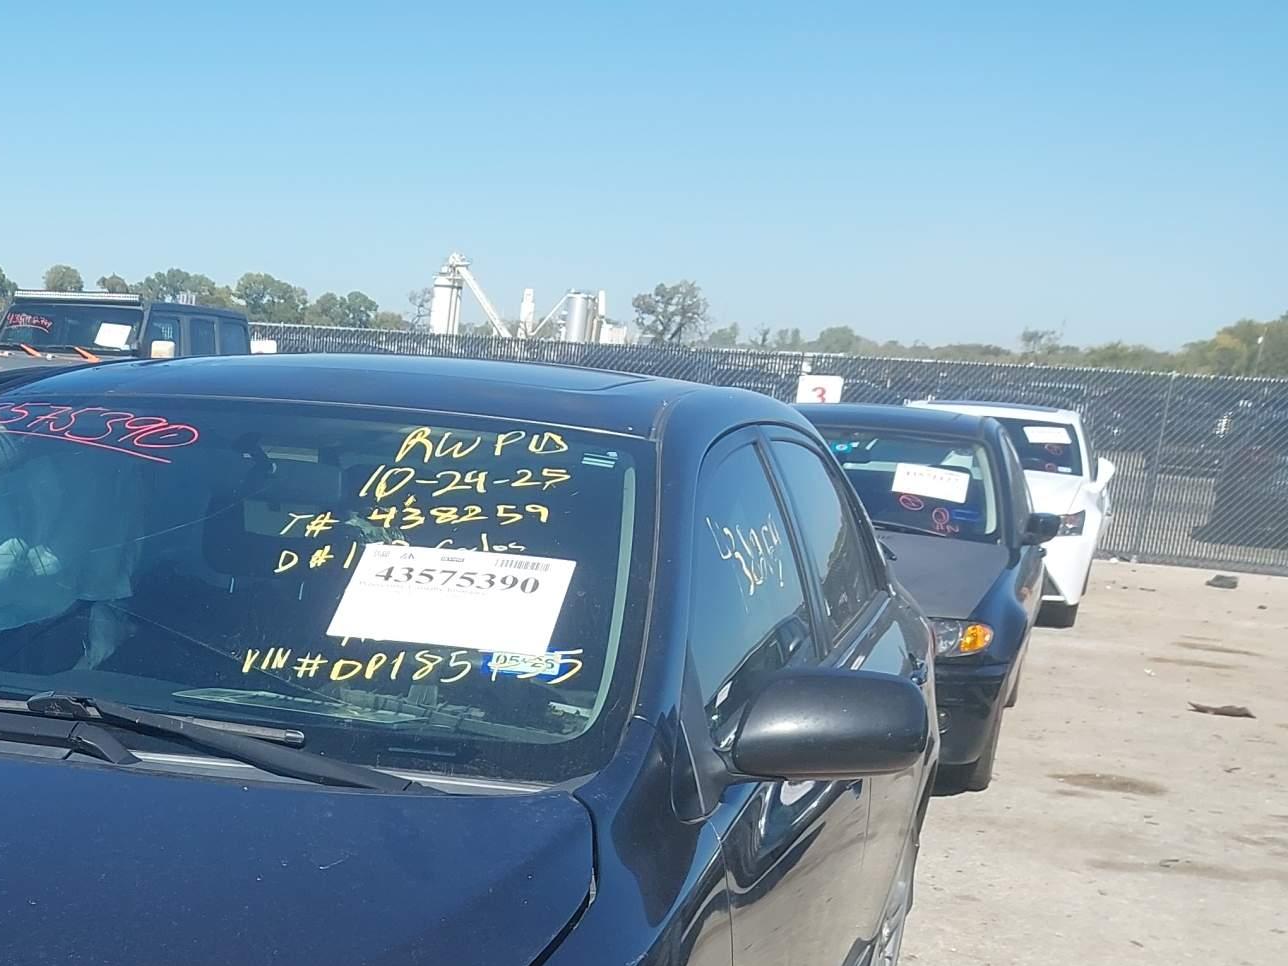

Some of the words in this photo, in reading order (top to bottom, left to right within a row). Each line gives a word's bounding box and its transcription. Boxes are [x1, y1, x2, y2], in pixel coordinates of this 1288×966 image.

[812, 386, 827, 403] 3
[368, 502, 549, 530] 438259
[376, 566, 540, 594] 43575390
